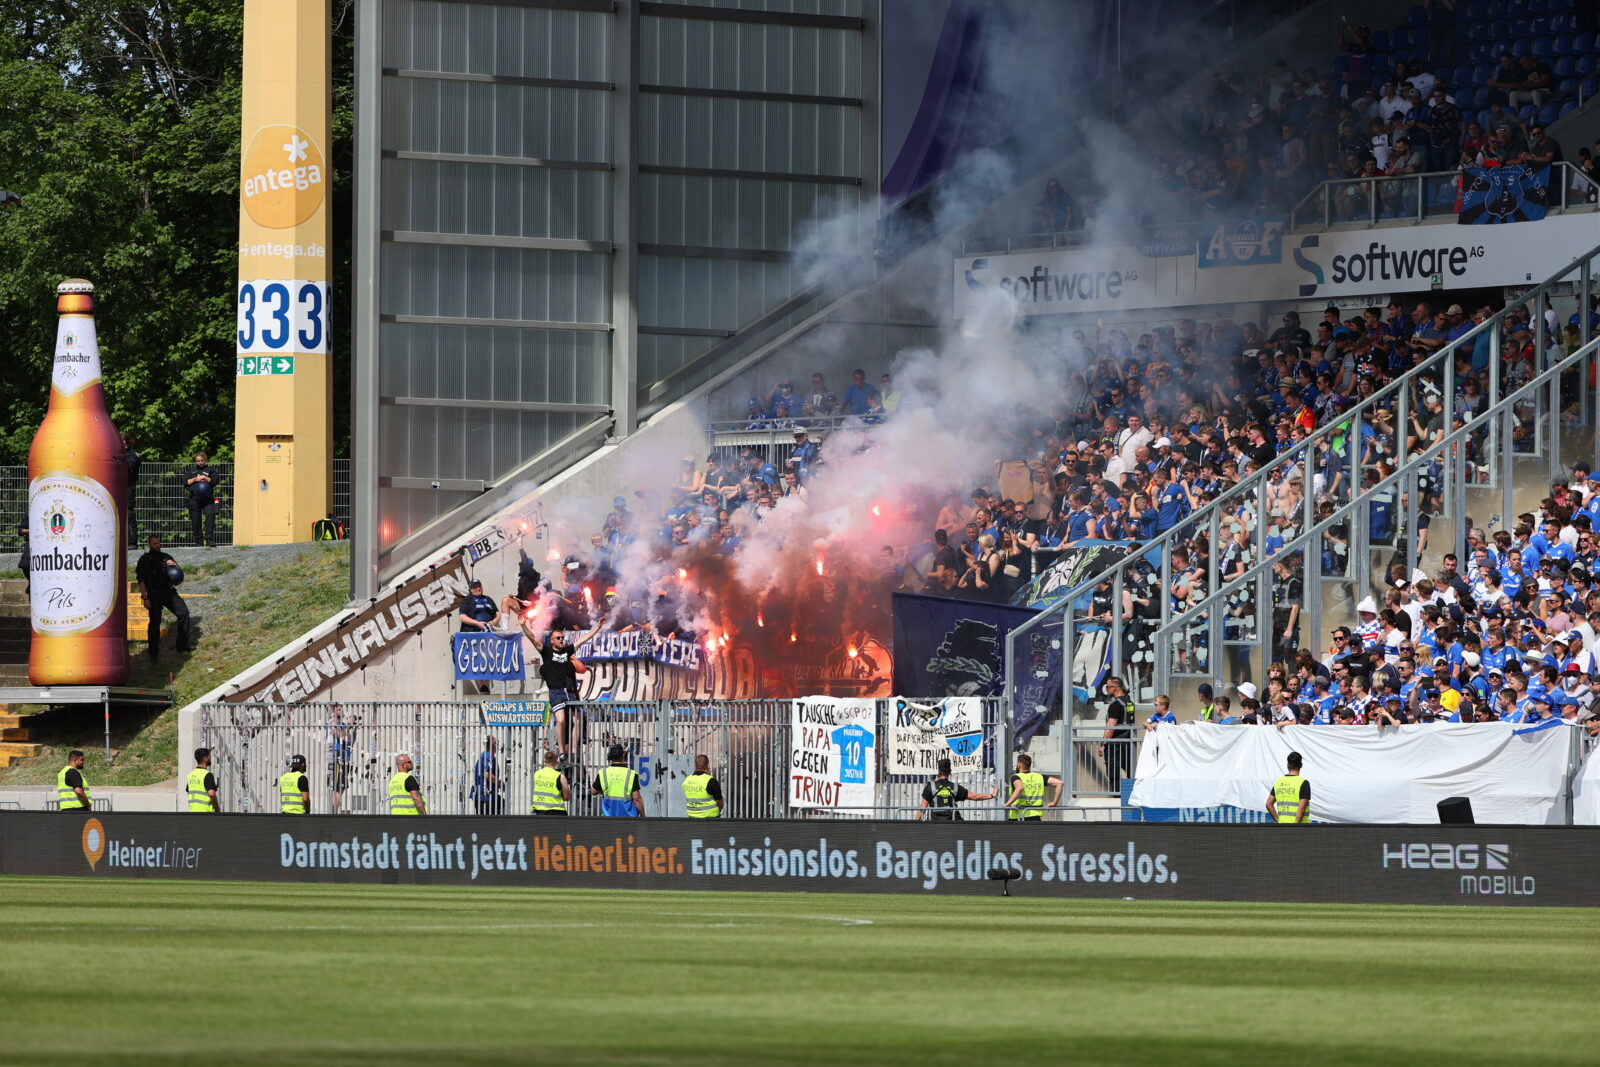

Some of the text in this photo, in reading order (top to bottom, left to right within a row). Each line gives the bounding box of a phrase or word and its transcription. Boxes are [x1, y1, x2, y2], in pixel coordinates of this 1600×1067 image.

[244, 164, 322, 198] entega
[1331, 242, 1485, 284] software AG
[1124, 270, 1138, 282] AG
[475, 537, 492, 556] PB
[41, 587, 76, 612] Pils
[457, 638, 520, 674] GESSELN
[525, 702, 545, 711] WEED
[796, 702, 838, 726] TAUSCHE
[802, 726, 831, 751] PAPA
[957, 739, 969, 753] 07
[792, 749, 828, 775] GEGEN
[845, 740, 861, 766] 10
[896, 748, 916, 768] DEIN
[791, 775, 842, 806] TRIKOT
[108, 839, 202, 869] HeinerLiner
[280, 832, 1179, 890] Darmstadt fährt jetzt HeinerLiner. Emissionslos. Bargeldlos. Stresslos.
[1460, 874, 1536, 895] MOBILO
